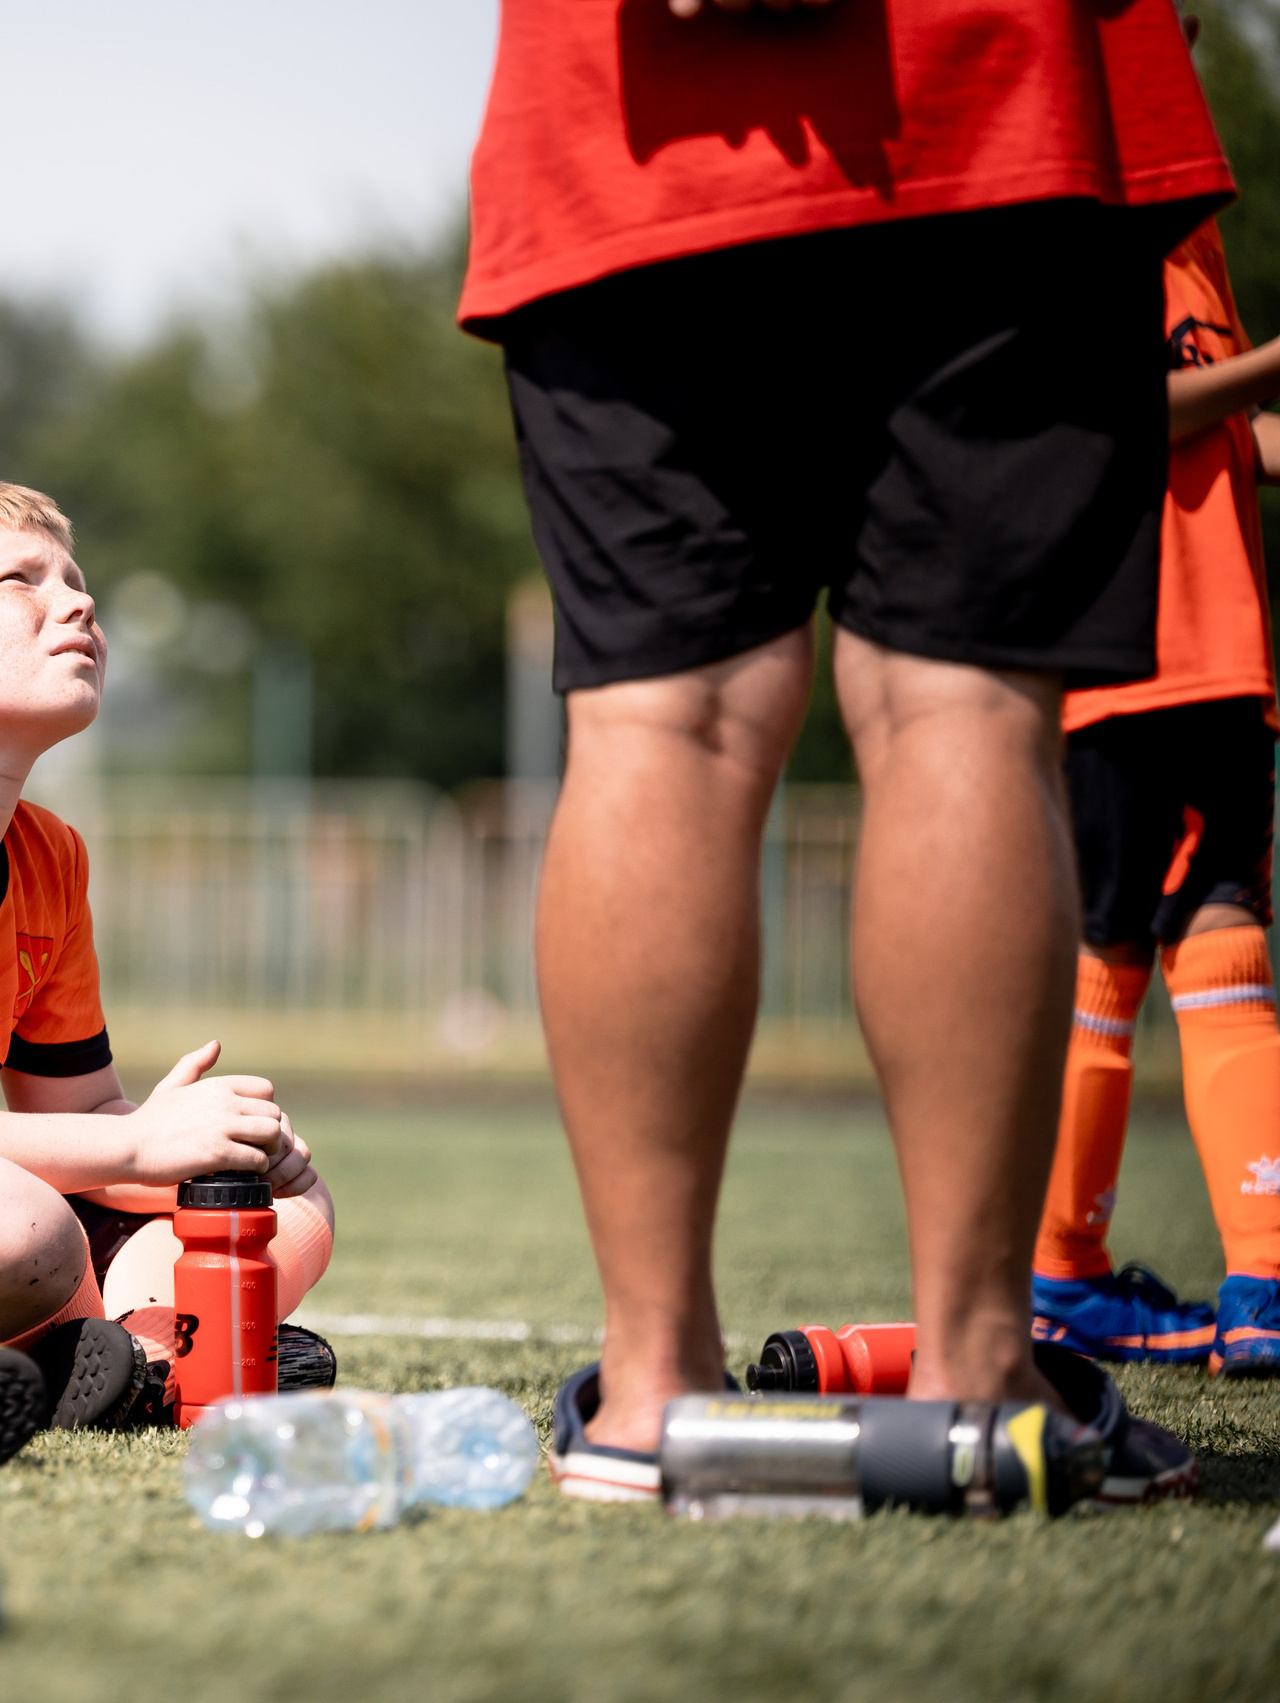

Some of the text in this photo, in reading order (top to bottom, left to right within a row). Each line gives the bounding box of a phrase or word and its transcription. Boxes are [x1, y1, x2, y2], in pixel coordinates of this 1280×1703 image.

[241, 1228, 257, 1237] 500
[241, 1281, 257, 1290] 400
[241, 1321, 257, 1330] 300
[241, 1358, 257, 1367] 200
